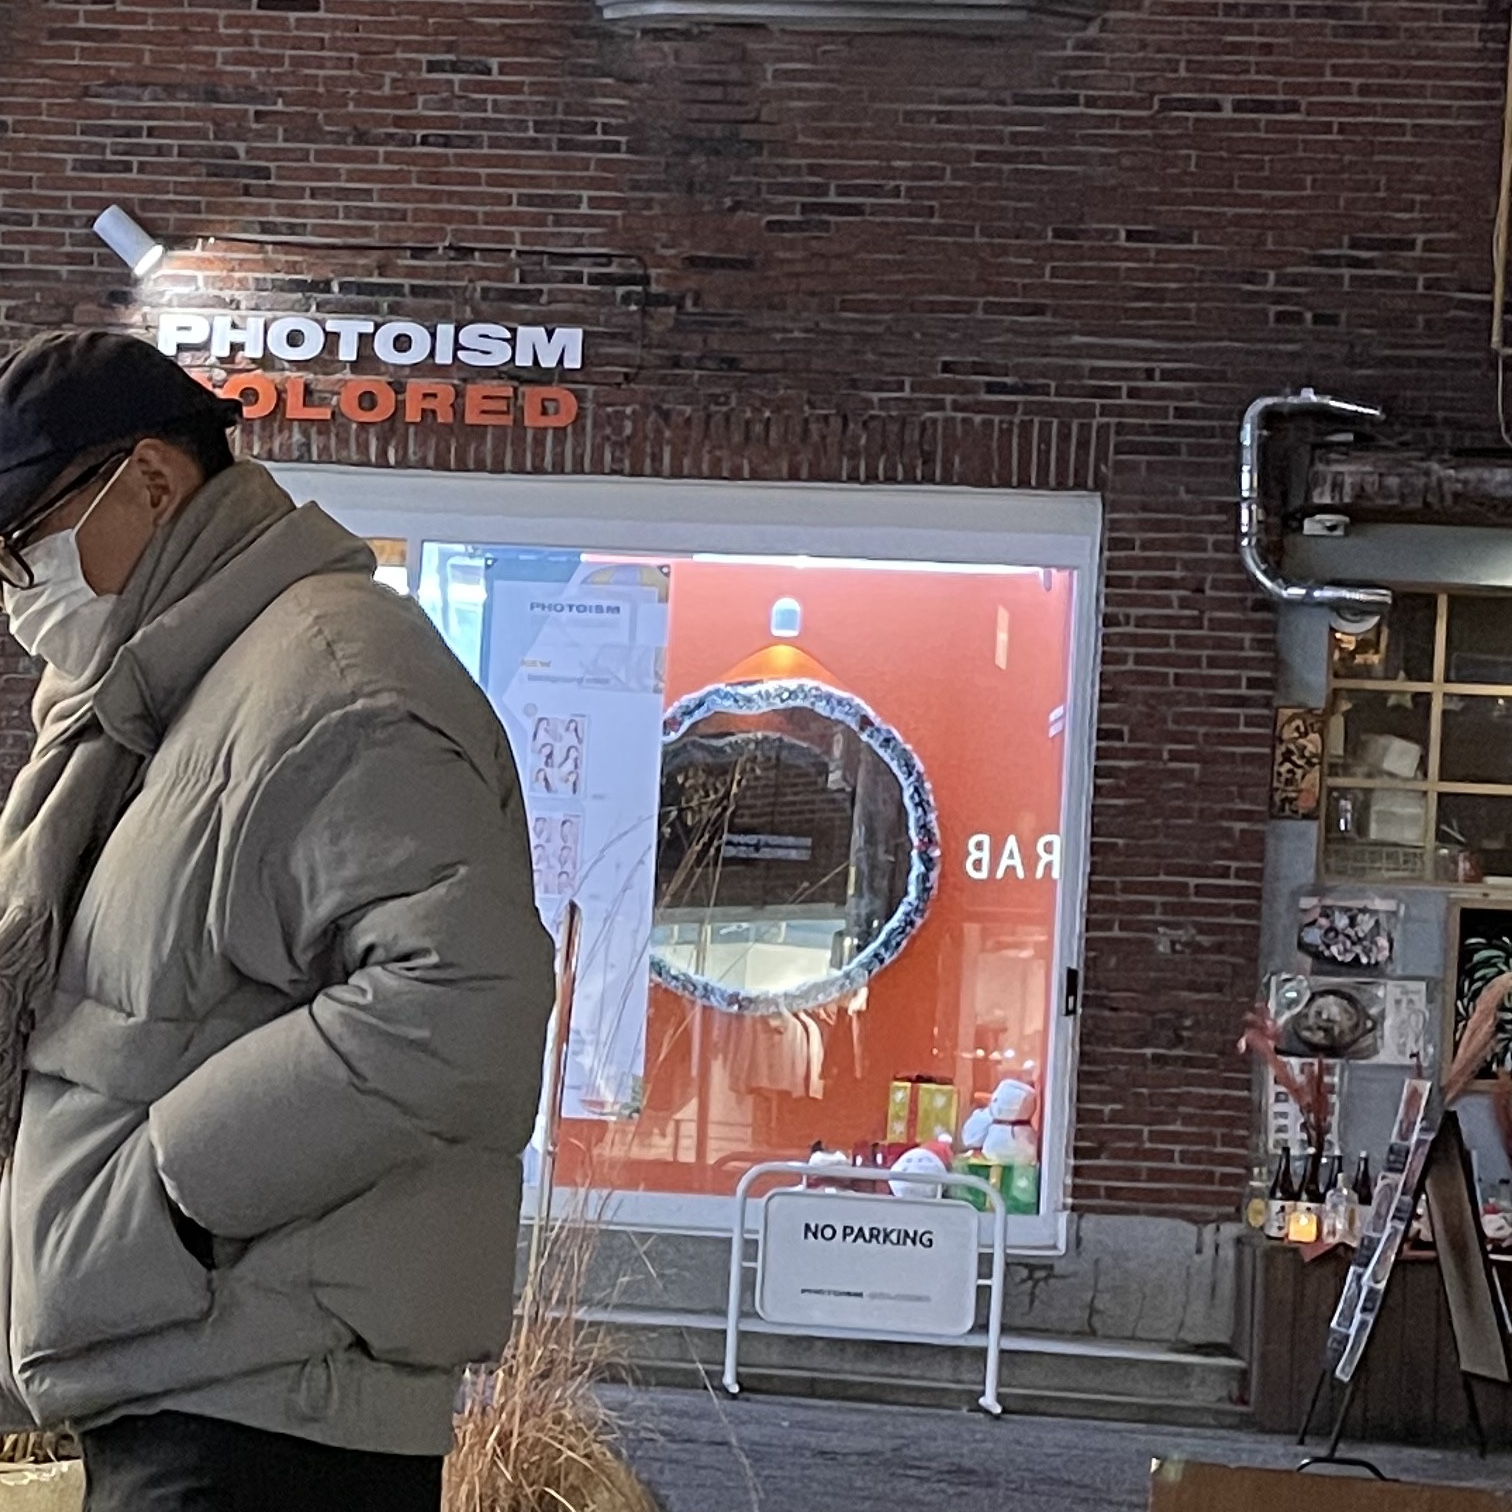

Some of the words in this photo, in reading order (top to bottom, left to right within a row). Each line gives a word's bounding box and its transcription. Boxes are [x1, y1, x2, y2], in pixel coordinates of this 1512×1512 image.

[157, 313, 585, 371] PHOTOISM
[190, 371, 579, 429] OLORED
[803, 1222, 837, 1241] NO
[841, 1225, 934, 1249] PARKING
